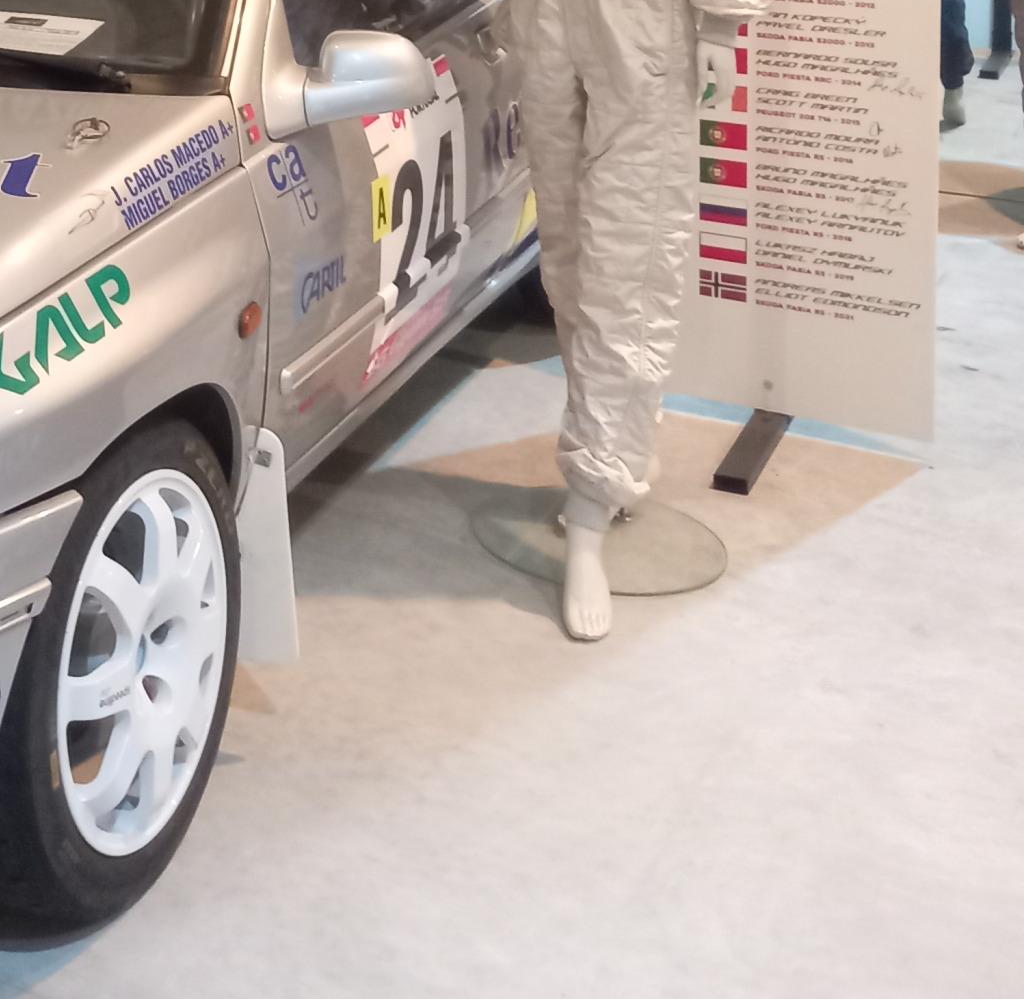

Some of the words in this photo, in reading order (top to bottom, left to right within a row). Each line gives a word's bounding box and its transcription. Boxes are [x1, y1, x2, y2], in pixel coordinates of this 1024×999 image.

[111, 184, 129, 206] J.
[125, 154, 175, 198] CARLOS
[175, 128, 218, 167] MACEDO
[218, 119, 235, 143] A+
[121, 185, 170, 231] MIGUEL
[170, 160, 212, 200] BORGES
[211, 151, 226, 173] A+
[378, 187, 387, 229] A
[385, 130, 462, 325] 24
